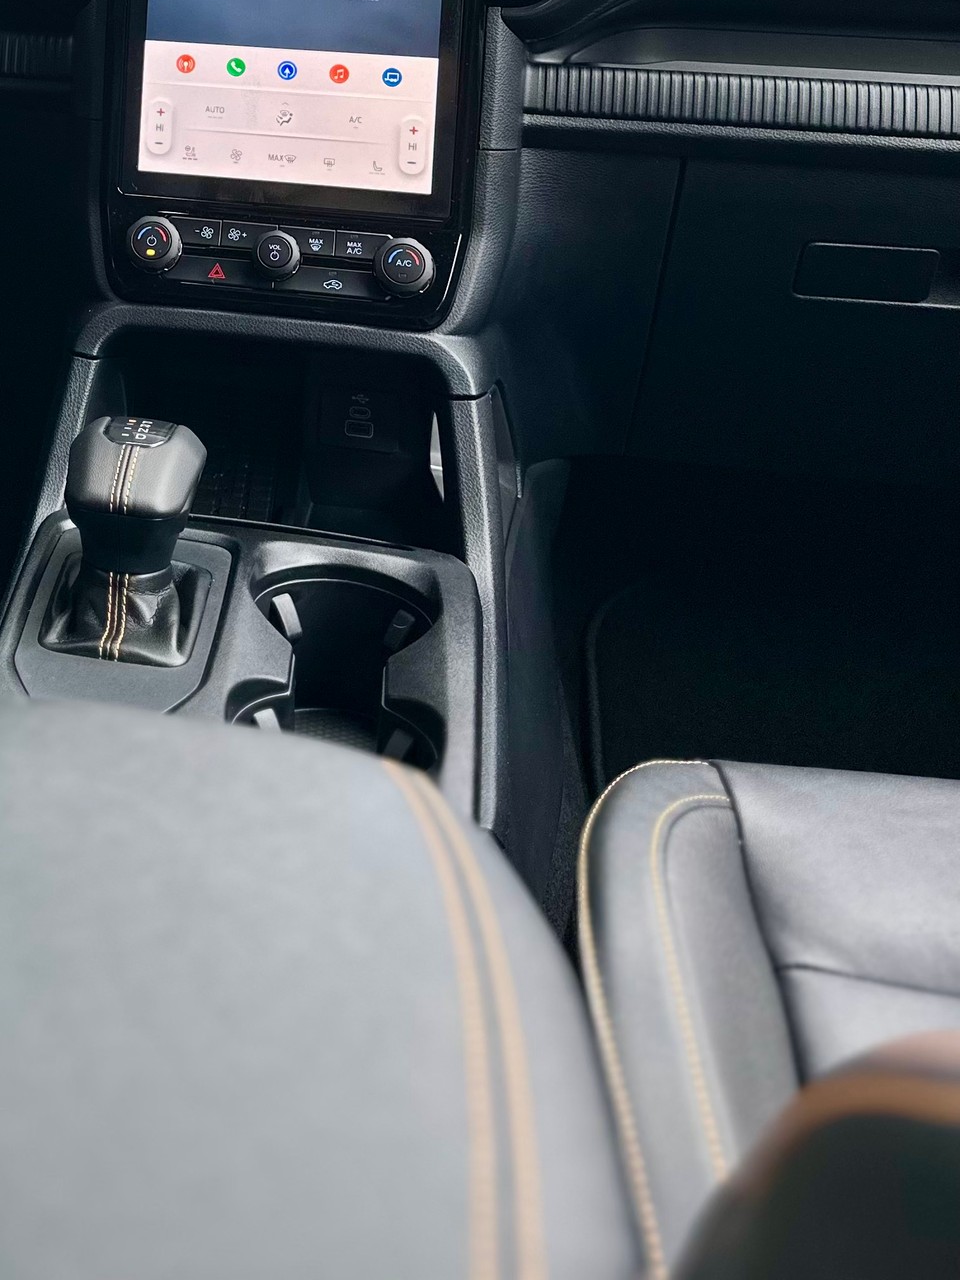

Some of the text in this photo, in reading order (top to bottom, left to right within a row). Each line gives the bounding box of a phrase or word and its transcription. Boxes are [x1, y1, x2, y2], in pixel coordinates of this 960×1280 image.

[205, 105, 225, 114] AUTO
[348, 115, 362, 124] A/C
[155, 123, 164, 132] HI
[408, 142, 417, 151] HI
[267, 153, 284, 162] MAX
[395, 259, 412, 267] A/C
